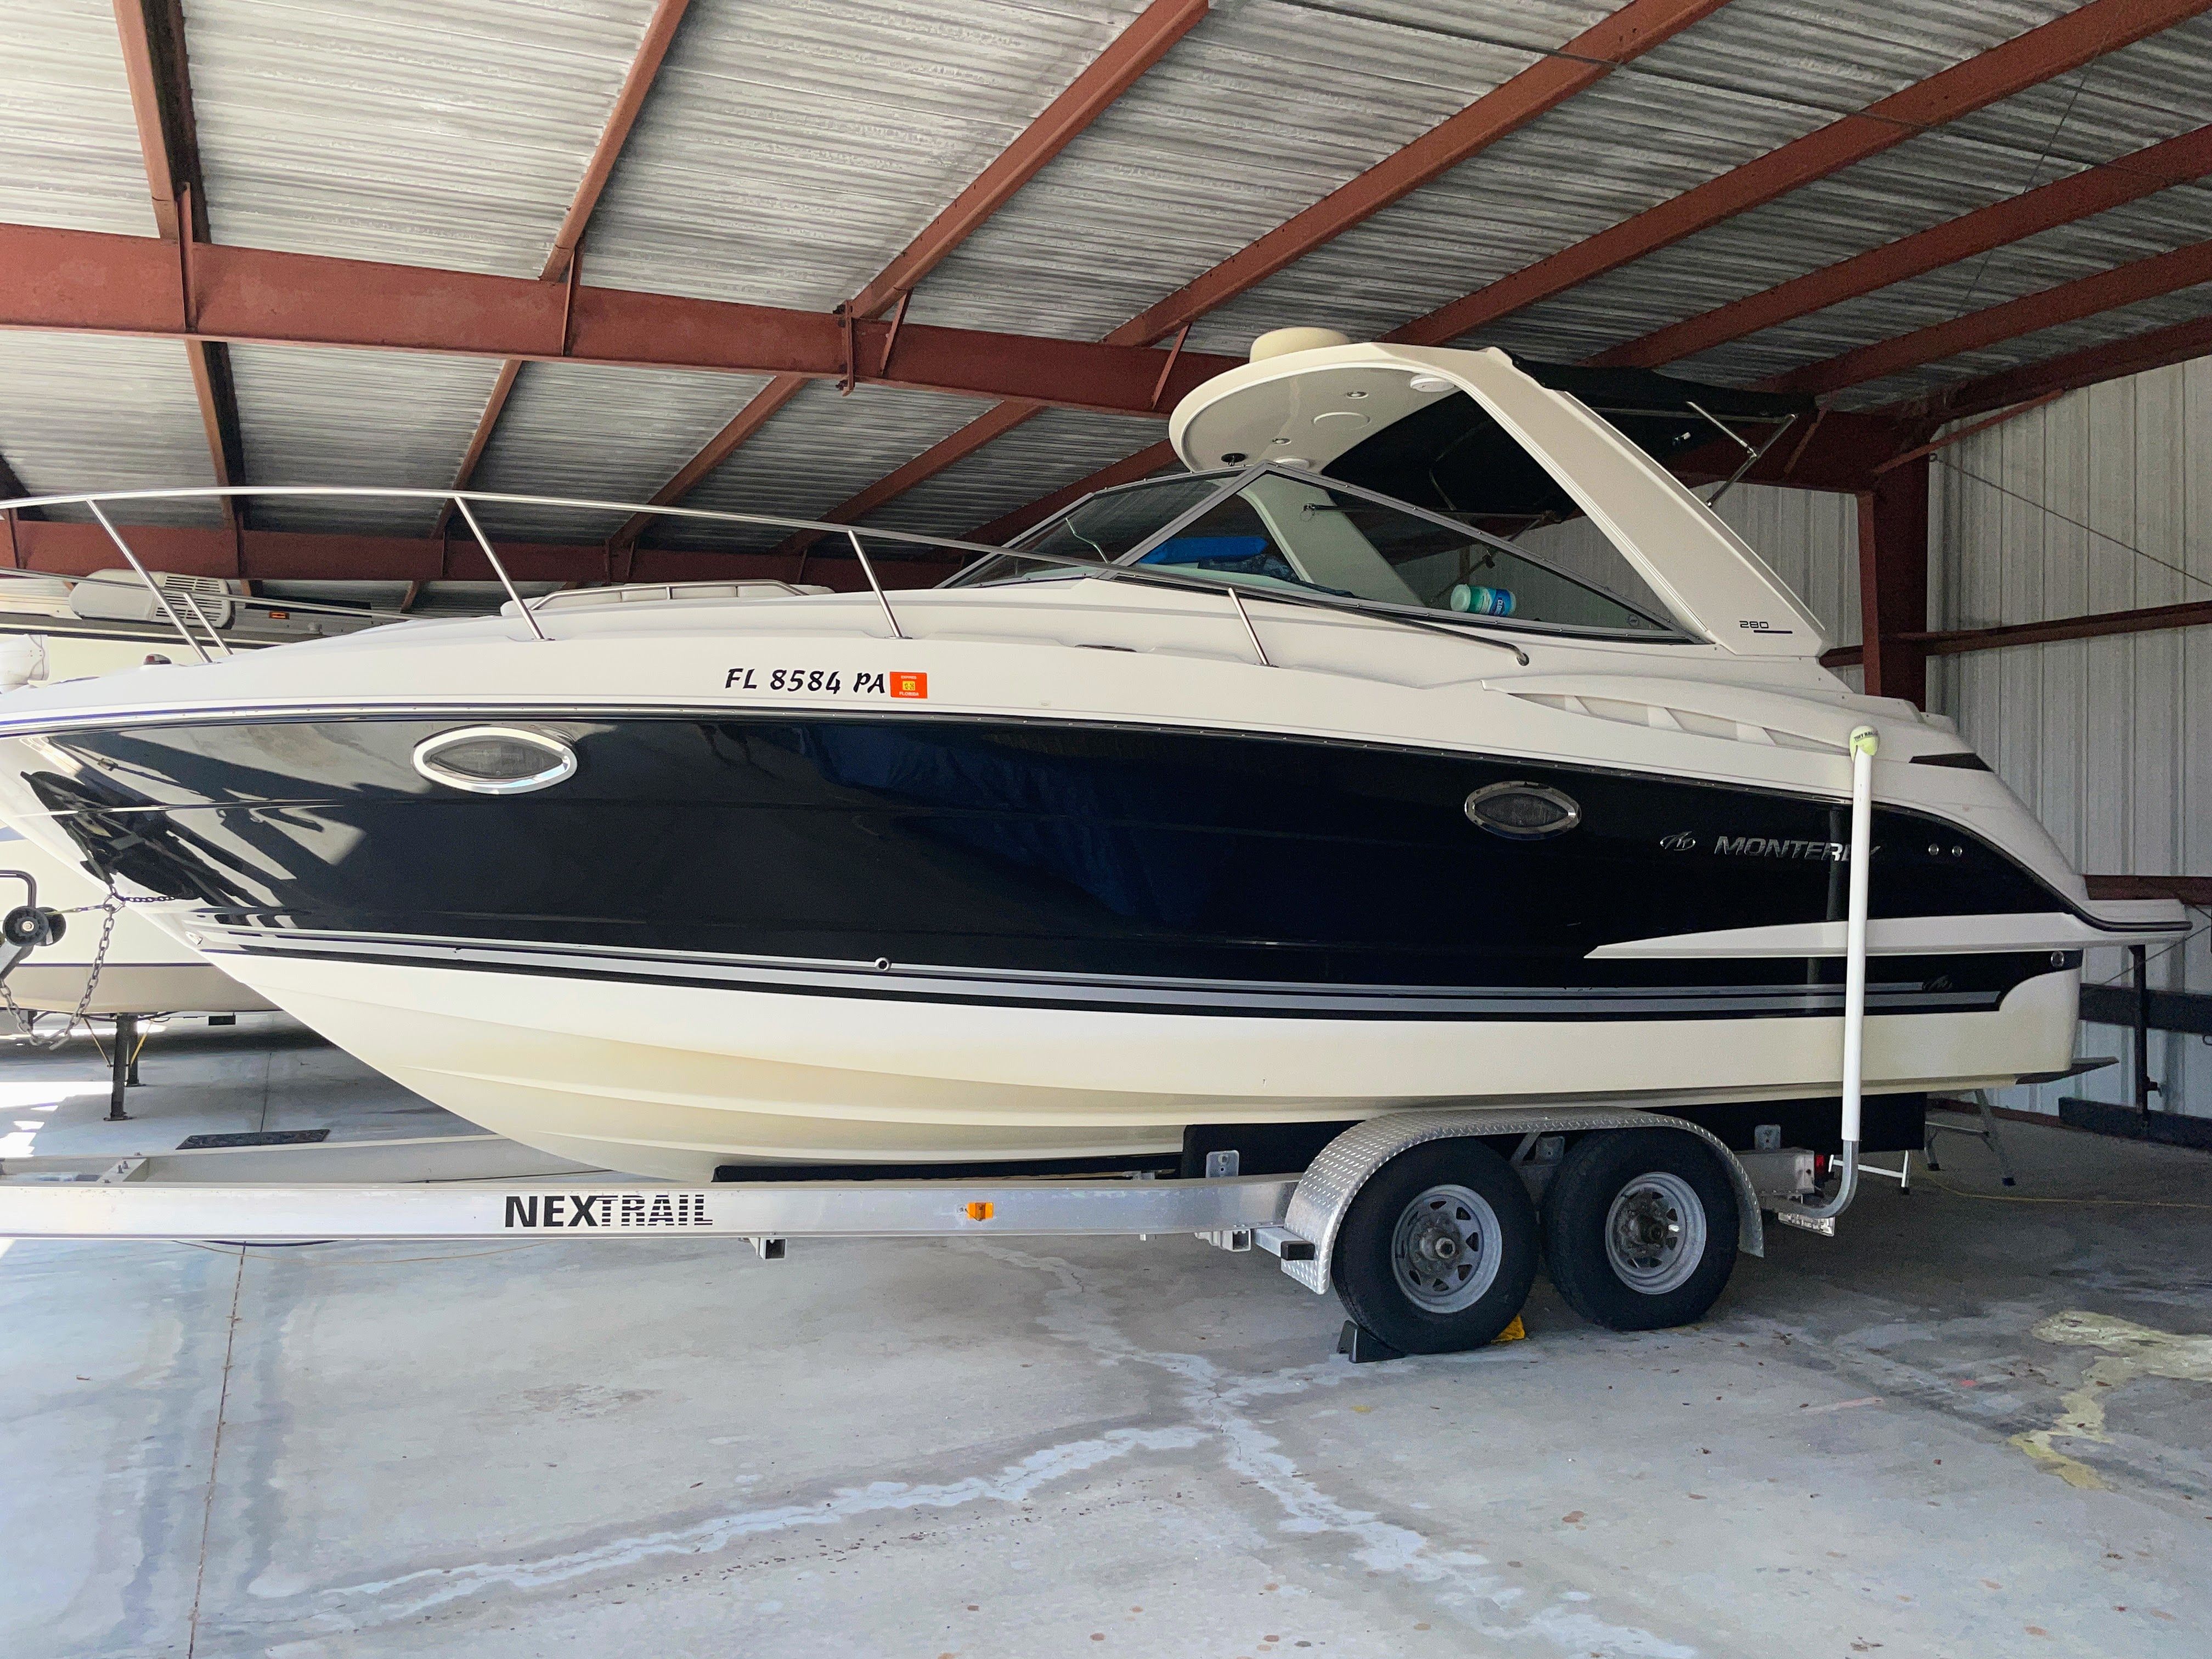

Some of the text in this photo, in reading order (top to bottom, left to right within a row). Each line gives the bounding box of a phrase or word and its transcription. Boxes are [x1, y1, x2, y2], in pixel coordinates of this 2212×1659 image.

[1739, 620, 1769, 629] 280
[725, 668, 886, 695] FL 8584 PA
[1714, 836, 1882, 861] MONTER
[505, 1194, 714, 1228] NEXTRAIL
